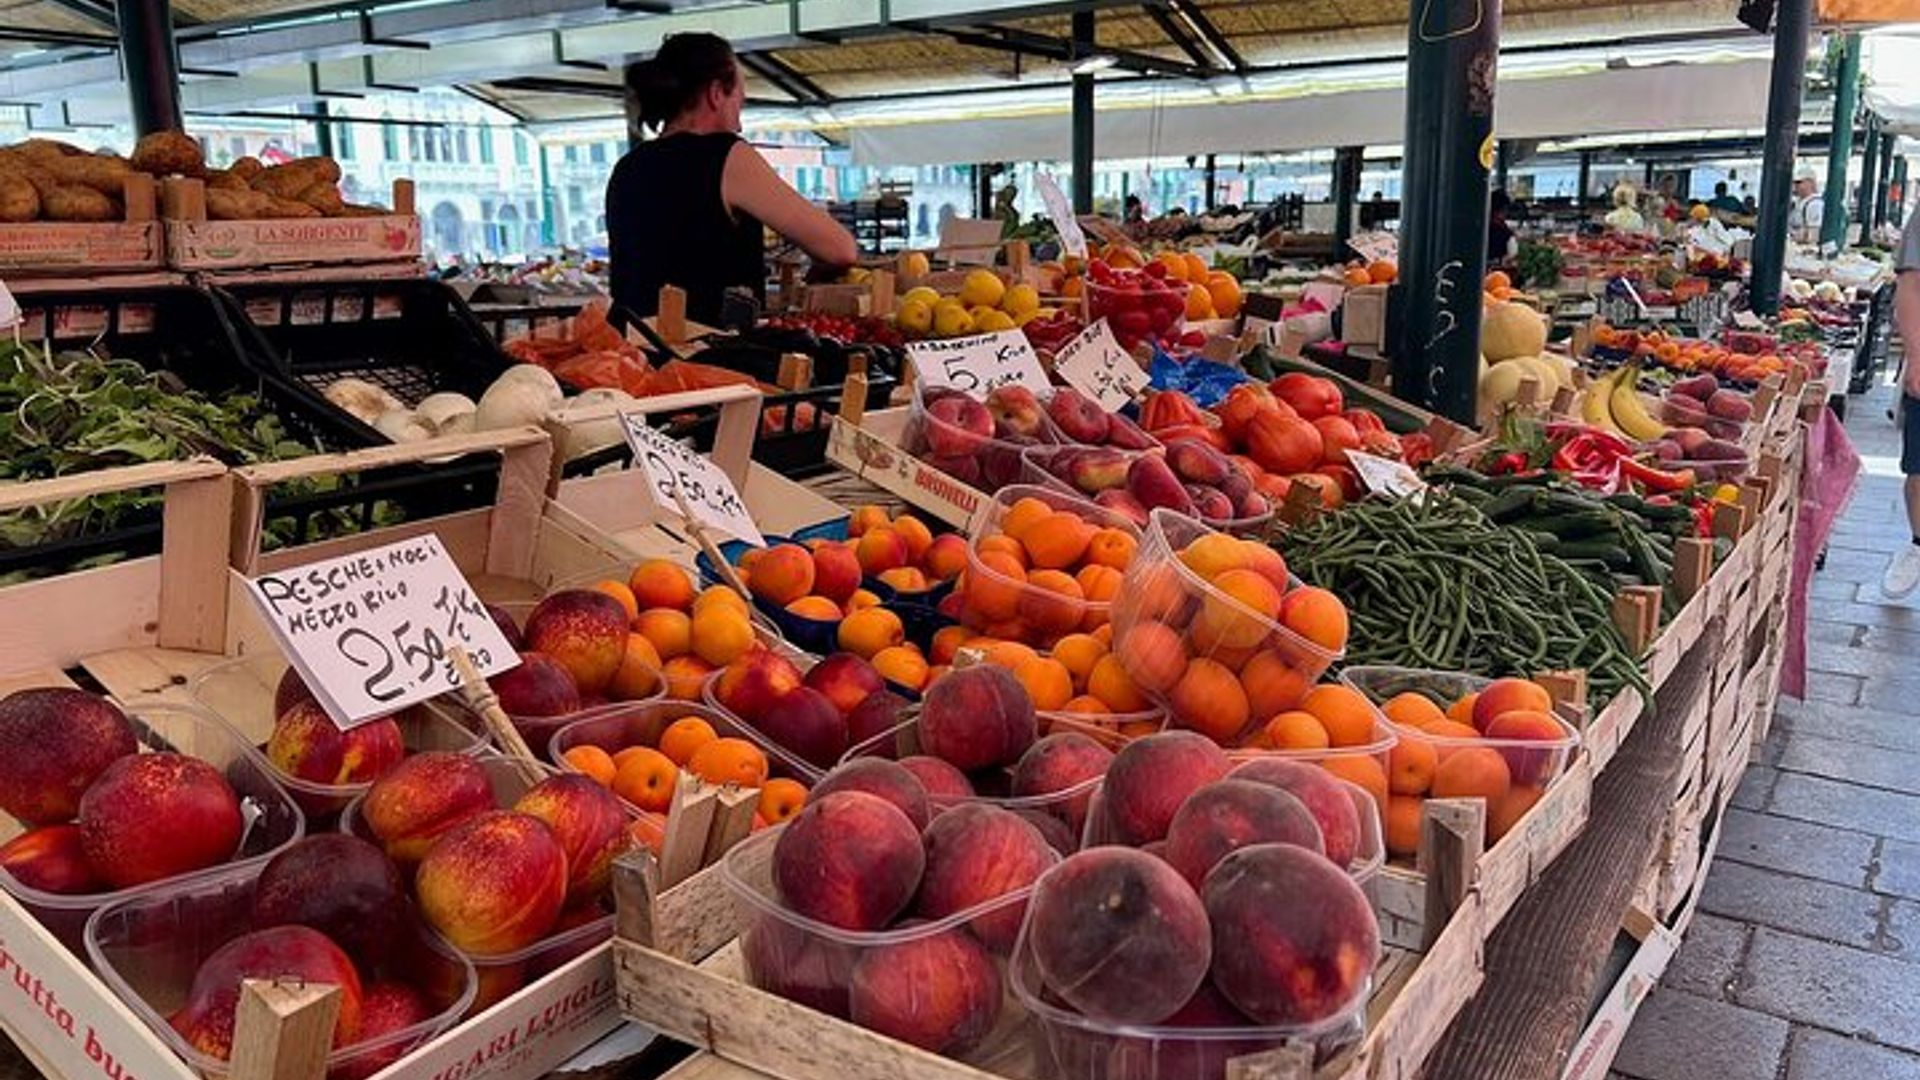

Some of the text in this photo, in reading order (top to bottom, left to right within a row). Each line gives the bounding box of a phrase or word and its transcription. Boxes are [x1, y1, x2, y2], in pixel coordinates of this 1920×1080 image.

[943, 356, 978, 391] 5
[258, 556, 375, 616] PESCHE
[288, 606, 359, 635] MEZZO
